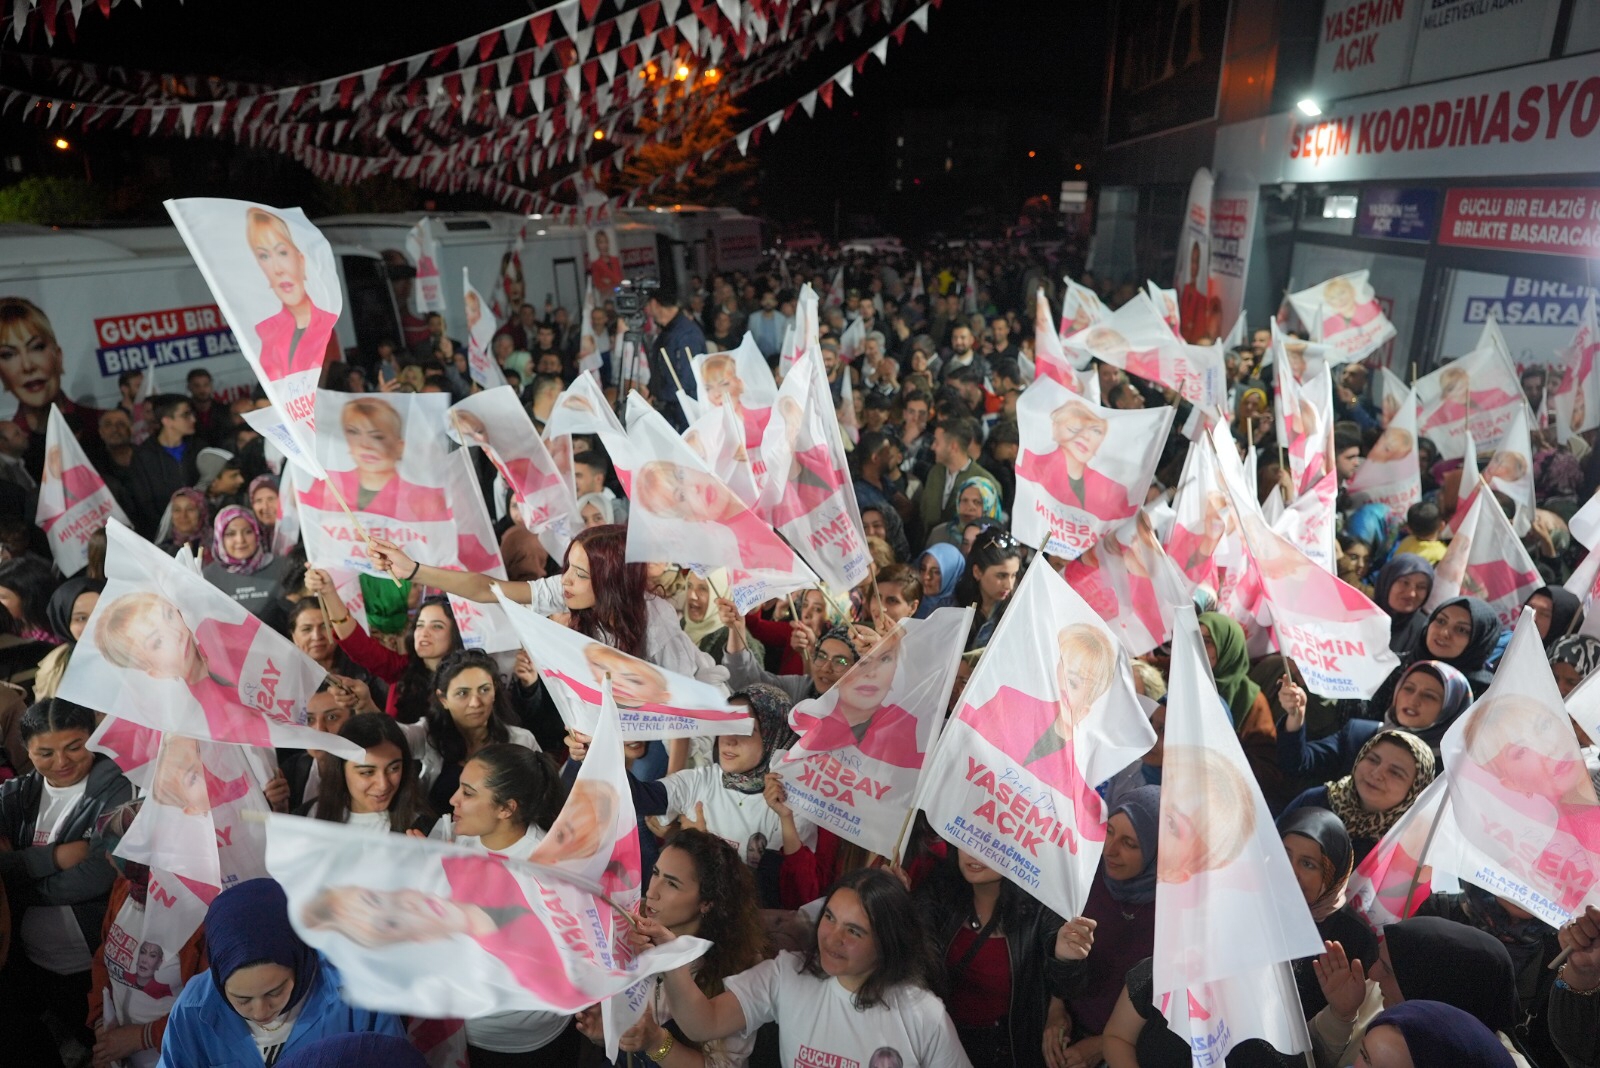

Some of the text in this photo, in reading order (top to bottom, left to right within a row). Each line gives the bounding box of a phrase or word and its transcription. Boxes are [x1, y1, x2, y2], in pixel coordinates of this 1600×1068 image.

[1529, 196, 1586, 219] ELAZIĞ
[101, 312, 178, 344] GÜÇLÜ
[183, 308, 217, 331] BİR
[103, 337, 202, 374] BİRLİKTE
[965, 755, 1078, 856] YASEMİN
[973, 799, 1044, 858] AÇIK
[944, 822, 1040, 889] MİLLETVEKİLİ ADAYI
[954, 815, 1041, 877] ELAZIĞ BAĞIMSIZ
